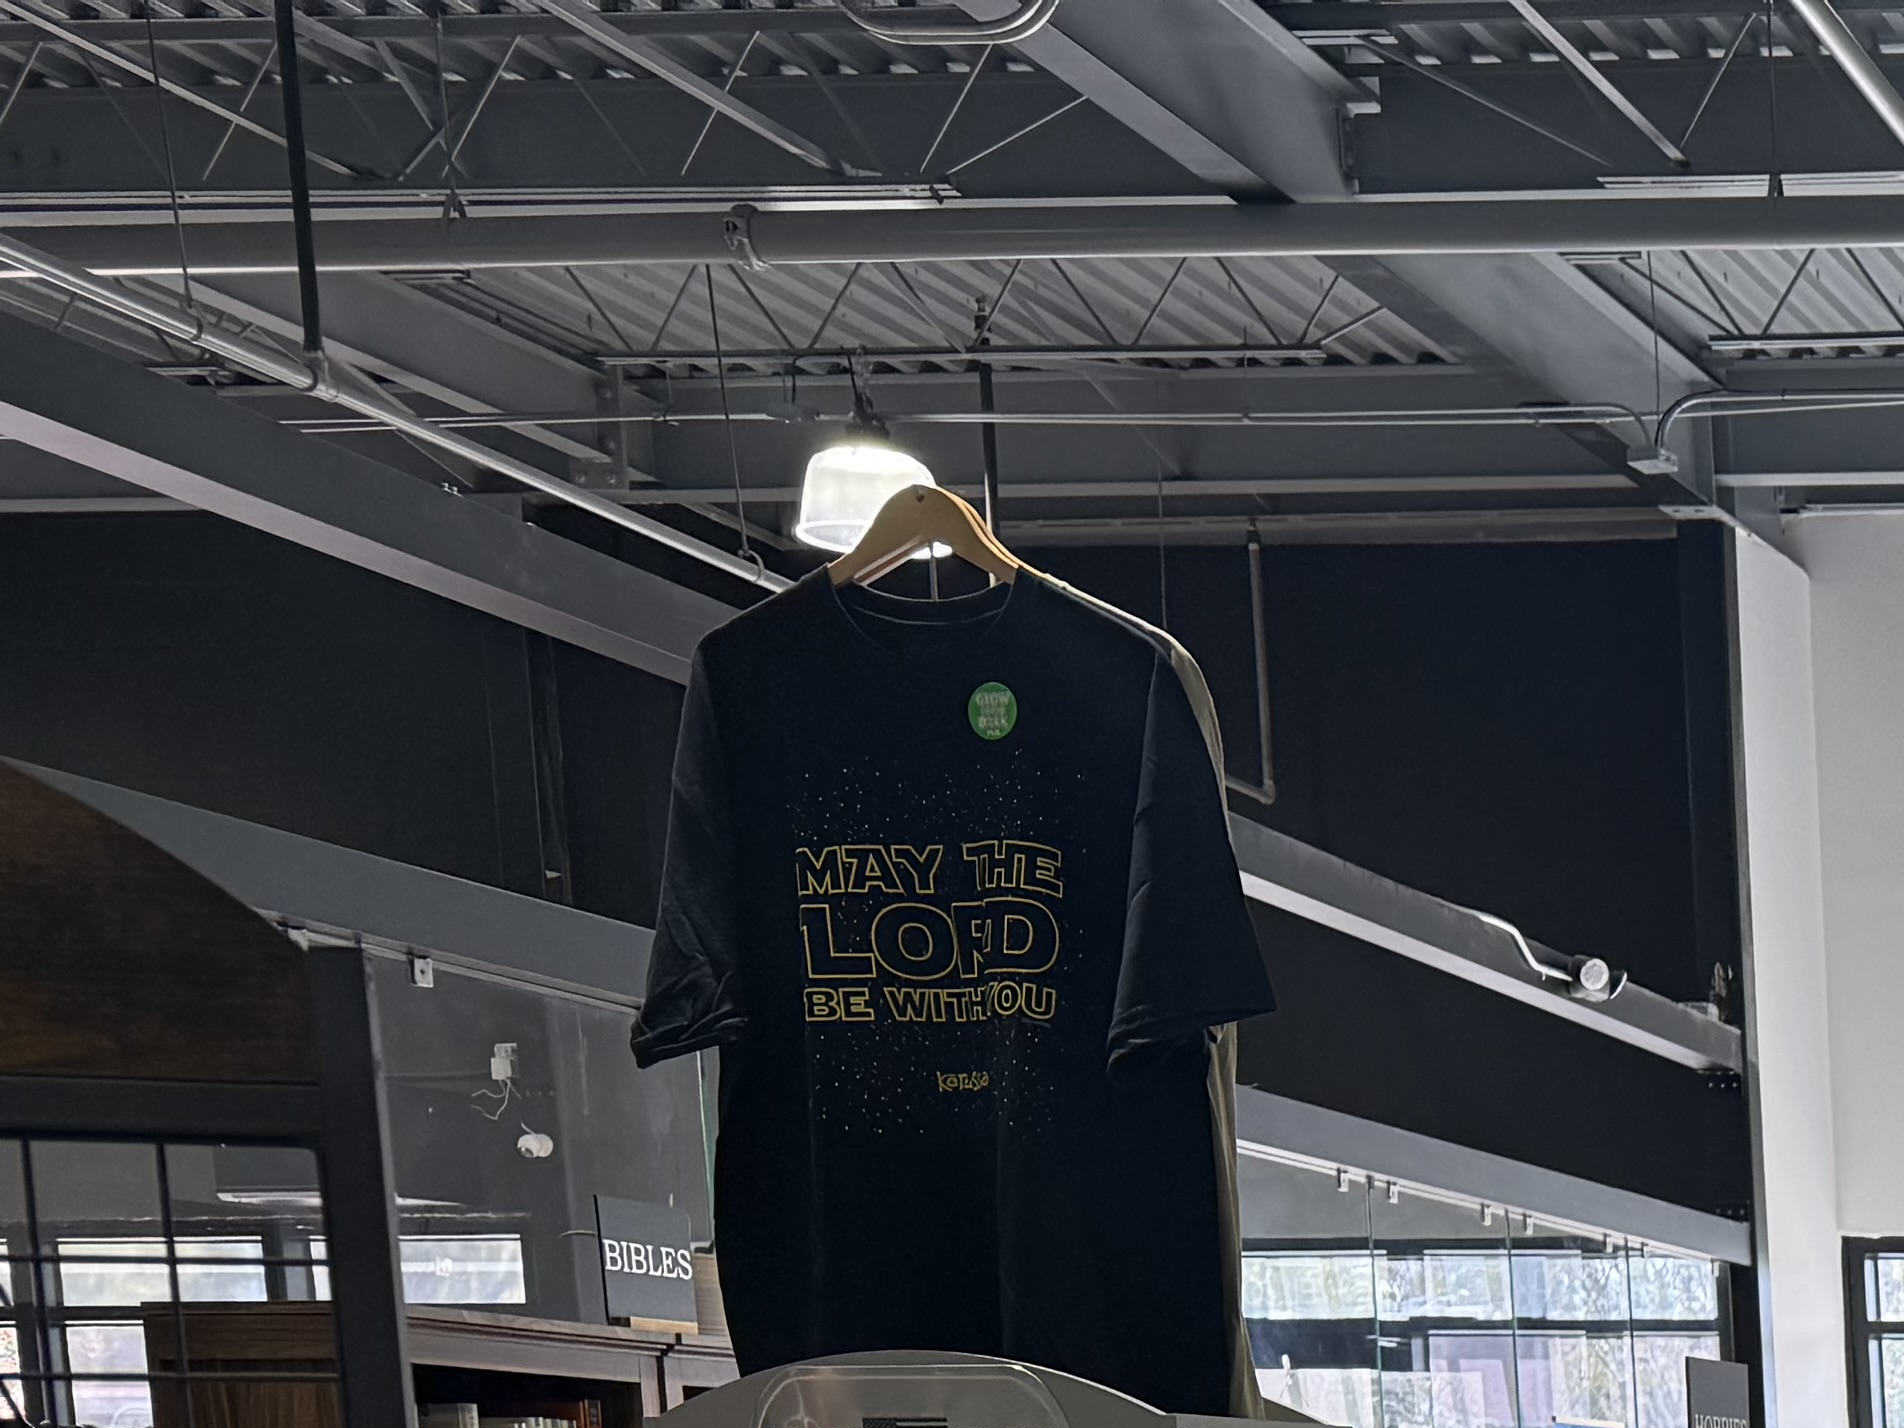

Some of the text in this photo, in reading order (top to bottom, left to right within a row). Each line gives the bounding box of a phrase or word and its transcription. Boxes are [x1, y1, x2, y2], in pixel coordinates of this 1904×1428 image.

[796, 839, 1063, 899] MAY THE
[803, 987, 876, 1021] BE
[602, 1239, 693, 1281] BIBLES
